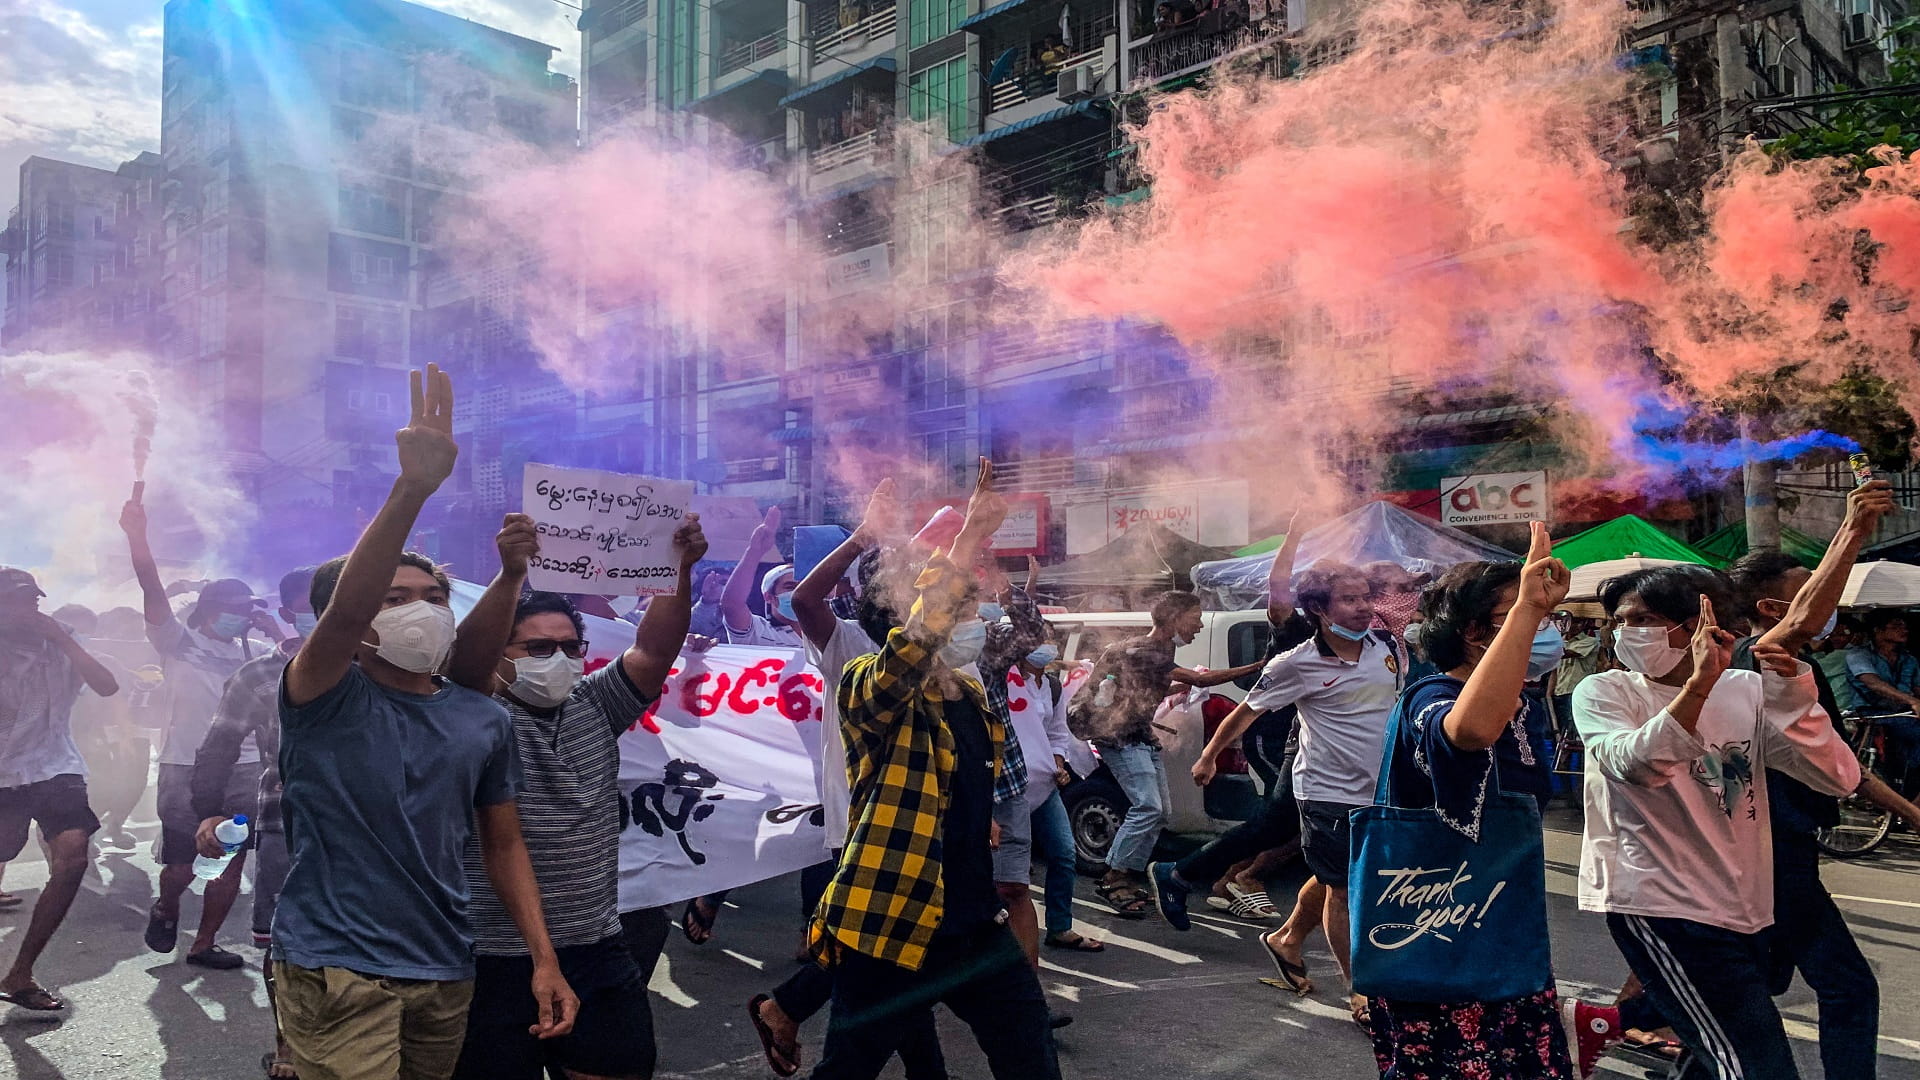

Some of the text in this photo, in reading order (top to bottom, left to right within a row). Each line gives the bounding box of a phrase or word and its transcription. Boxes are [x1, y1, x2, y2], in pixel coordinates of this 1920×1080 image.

[1449, 511, 1540, 523] CONVENIENCE STORE
[1450, 480, 1538, 513] abc
[1376, 860, 1473, 909] Thank
[1369, 881, 1506, 950] you!
